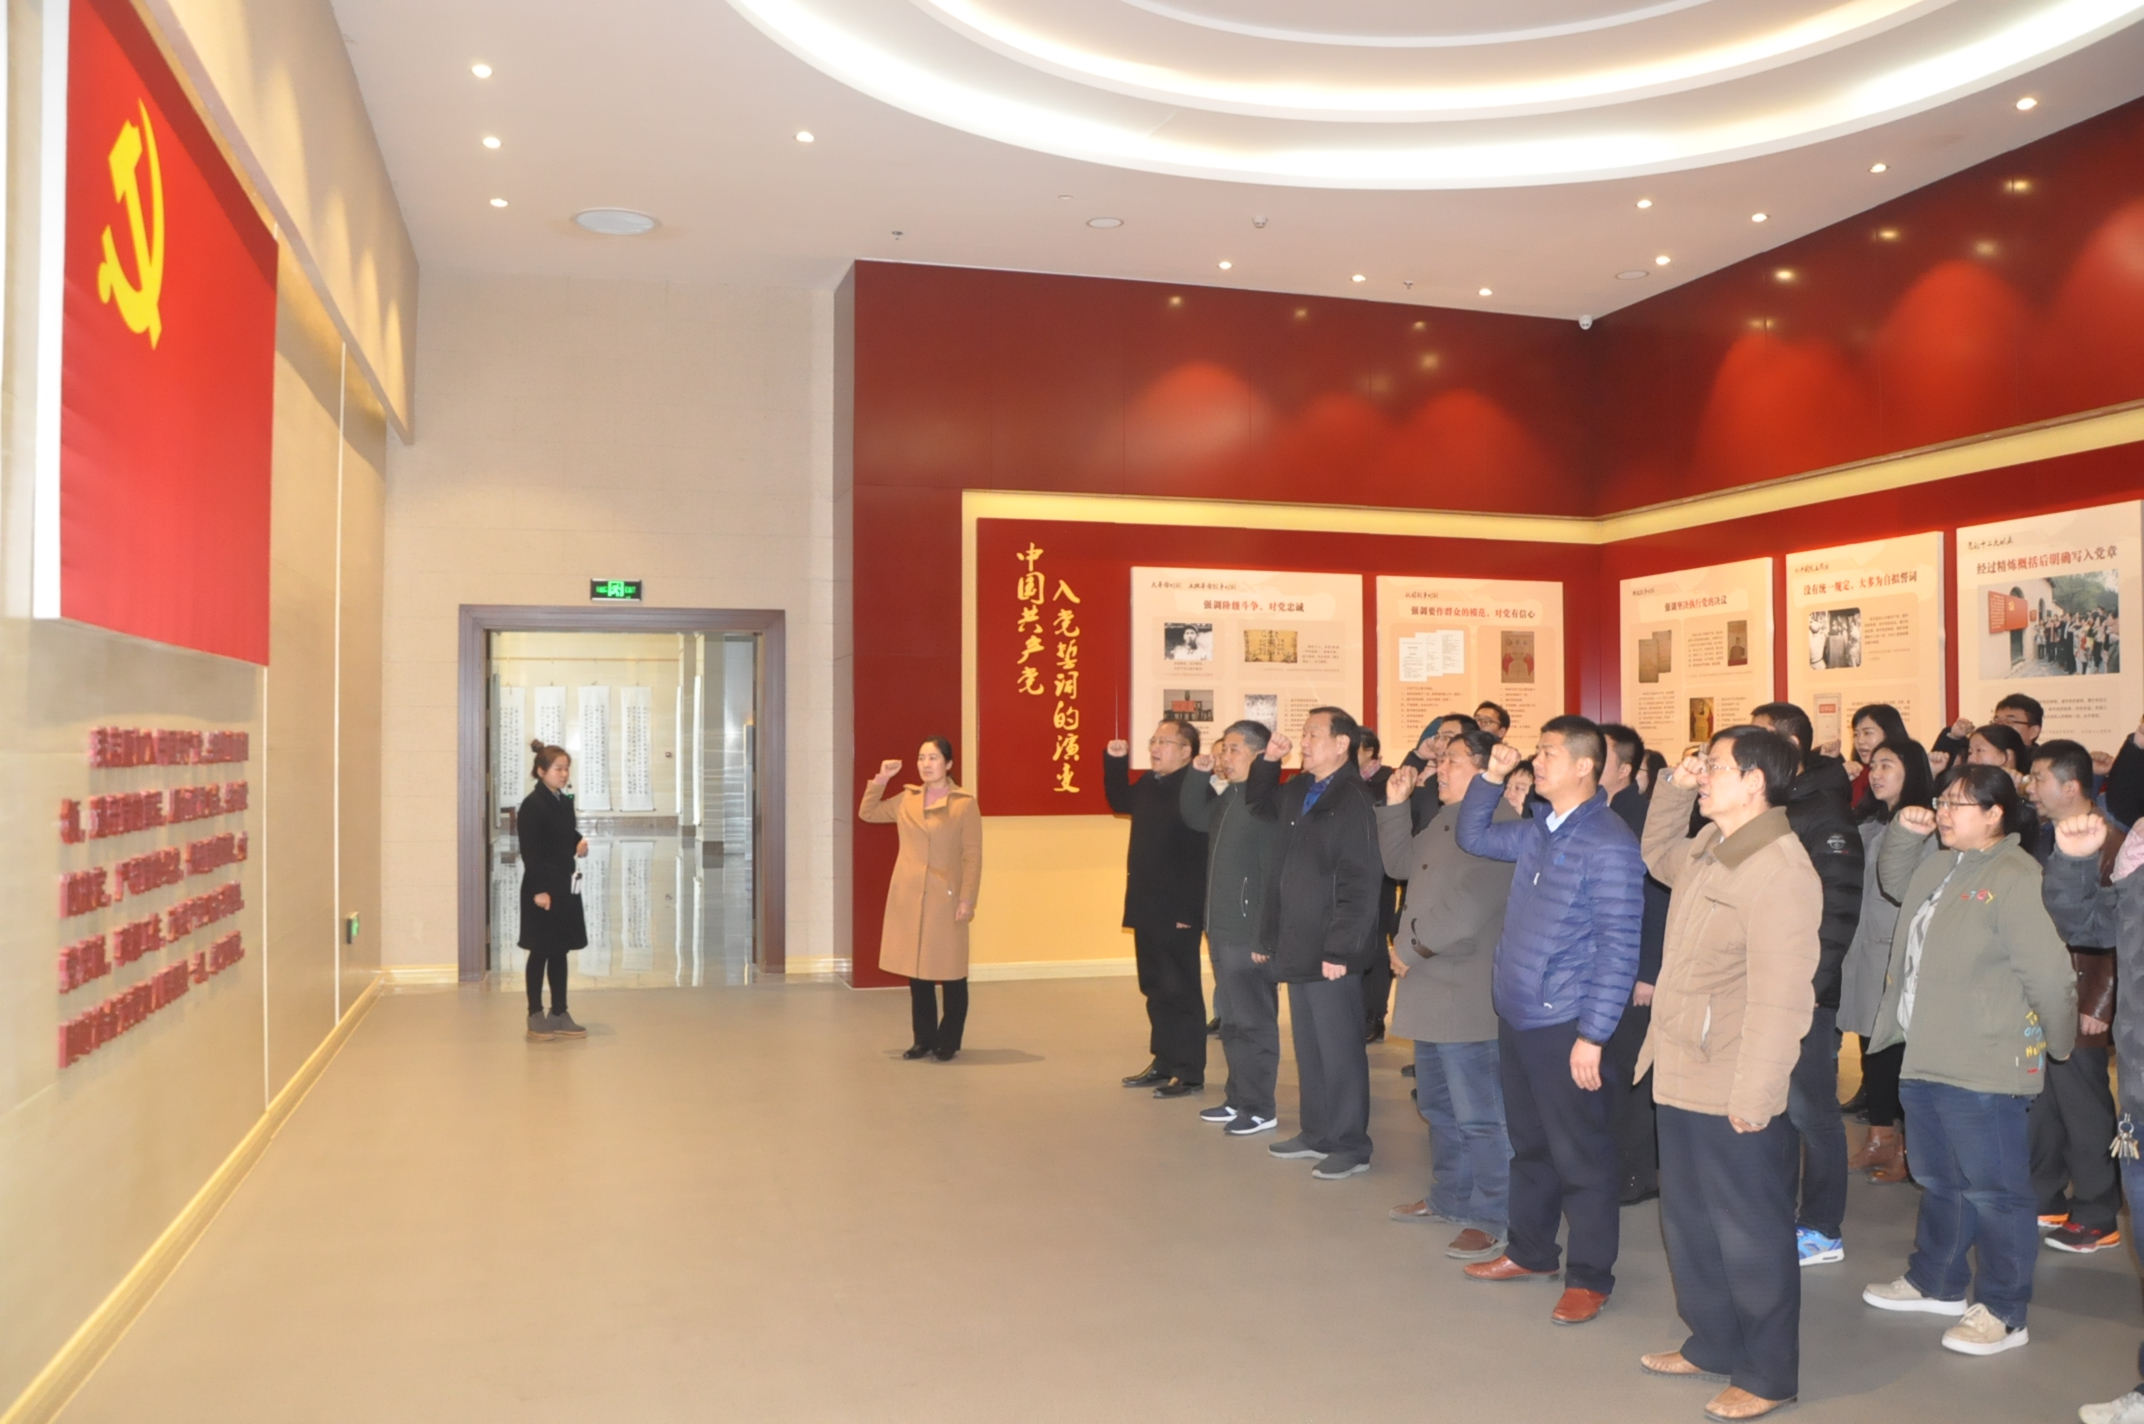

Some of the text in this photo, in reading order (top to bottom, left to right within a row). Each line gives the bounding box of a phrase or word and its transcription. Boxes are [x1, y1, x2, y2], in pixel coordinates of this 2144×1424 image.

[1016, 542, 1045, 695] 中国共产党
[1976, 545, 2118, 575] 经过精炼概括后明确写入党章
[1052, 579, 1081, 793] 入党誓词的演变
